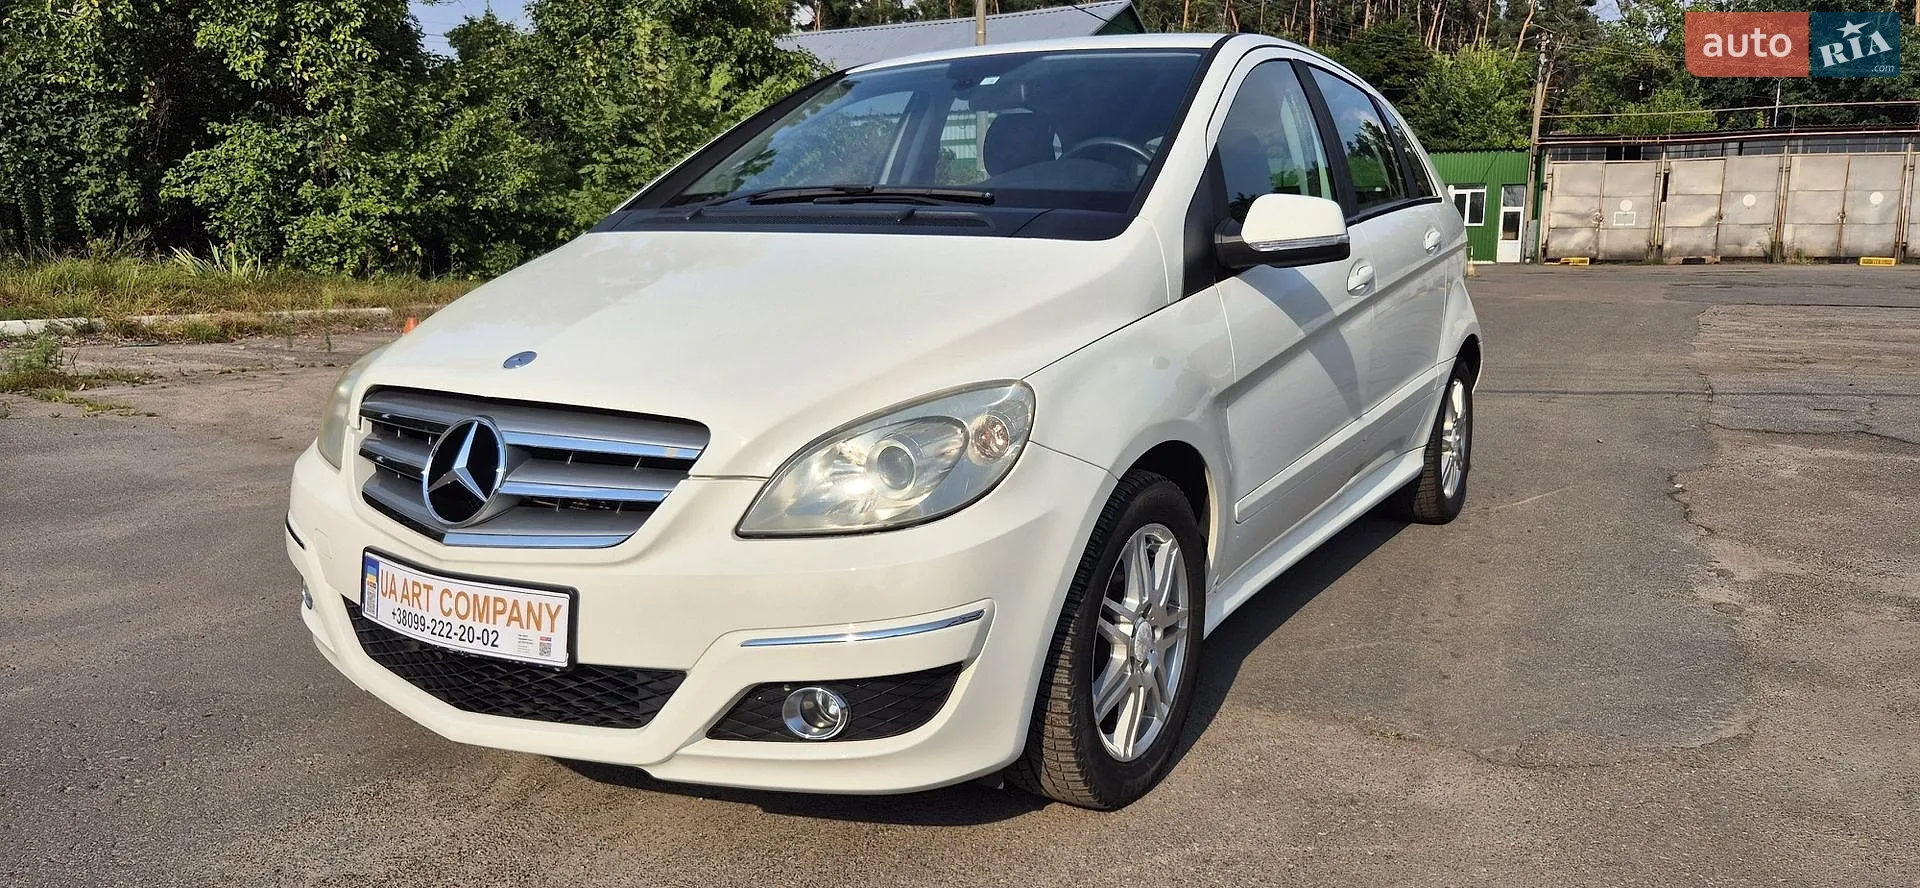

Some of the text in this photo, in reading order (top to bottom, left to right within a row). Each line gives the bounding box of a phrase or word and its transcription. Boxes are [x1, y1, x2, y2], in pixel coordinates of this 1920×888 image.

[380, 569, 563, 633] UA ART COMPANY
[391, 607, 499, 648] +38099-222-20-02
